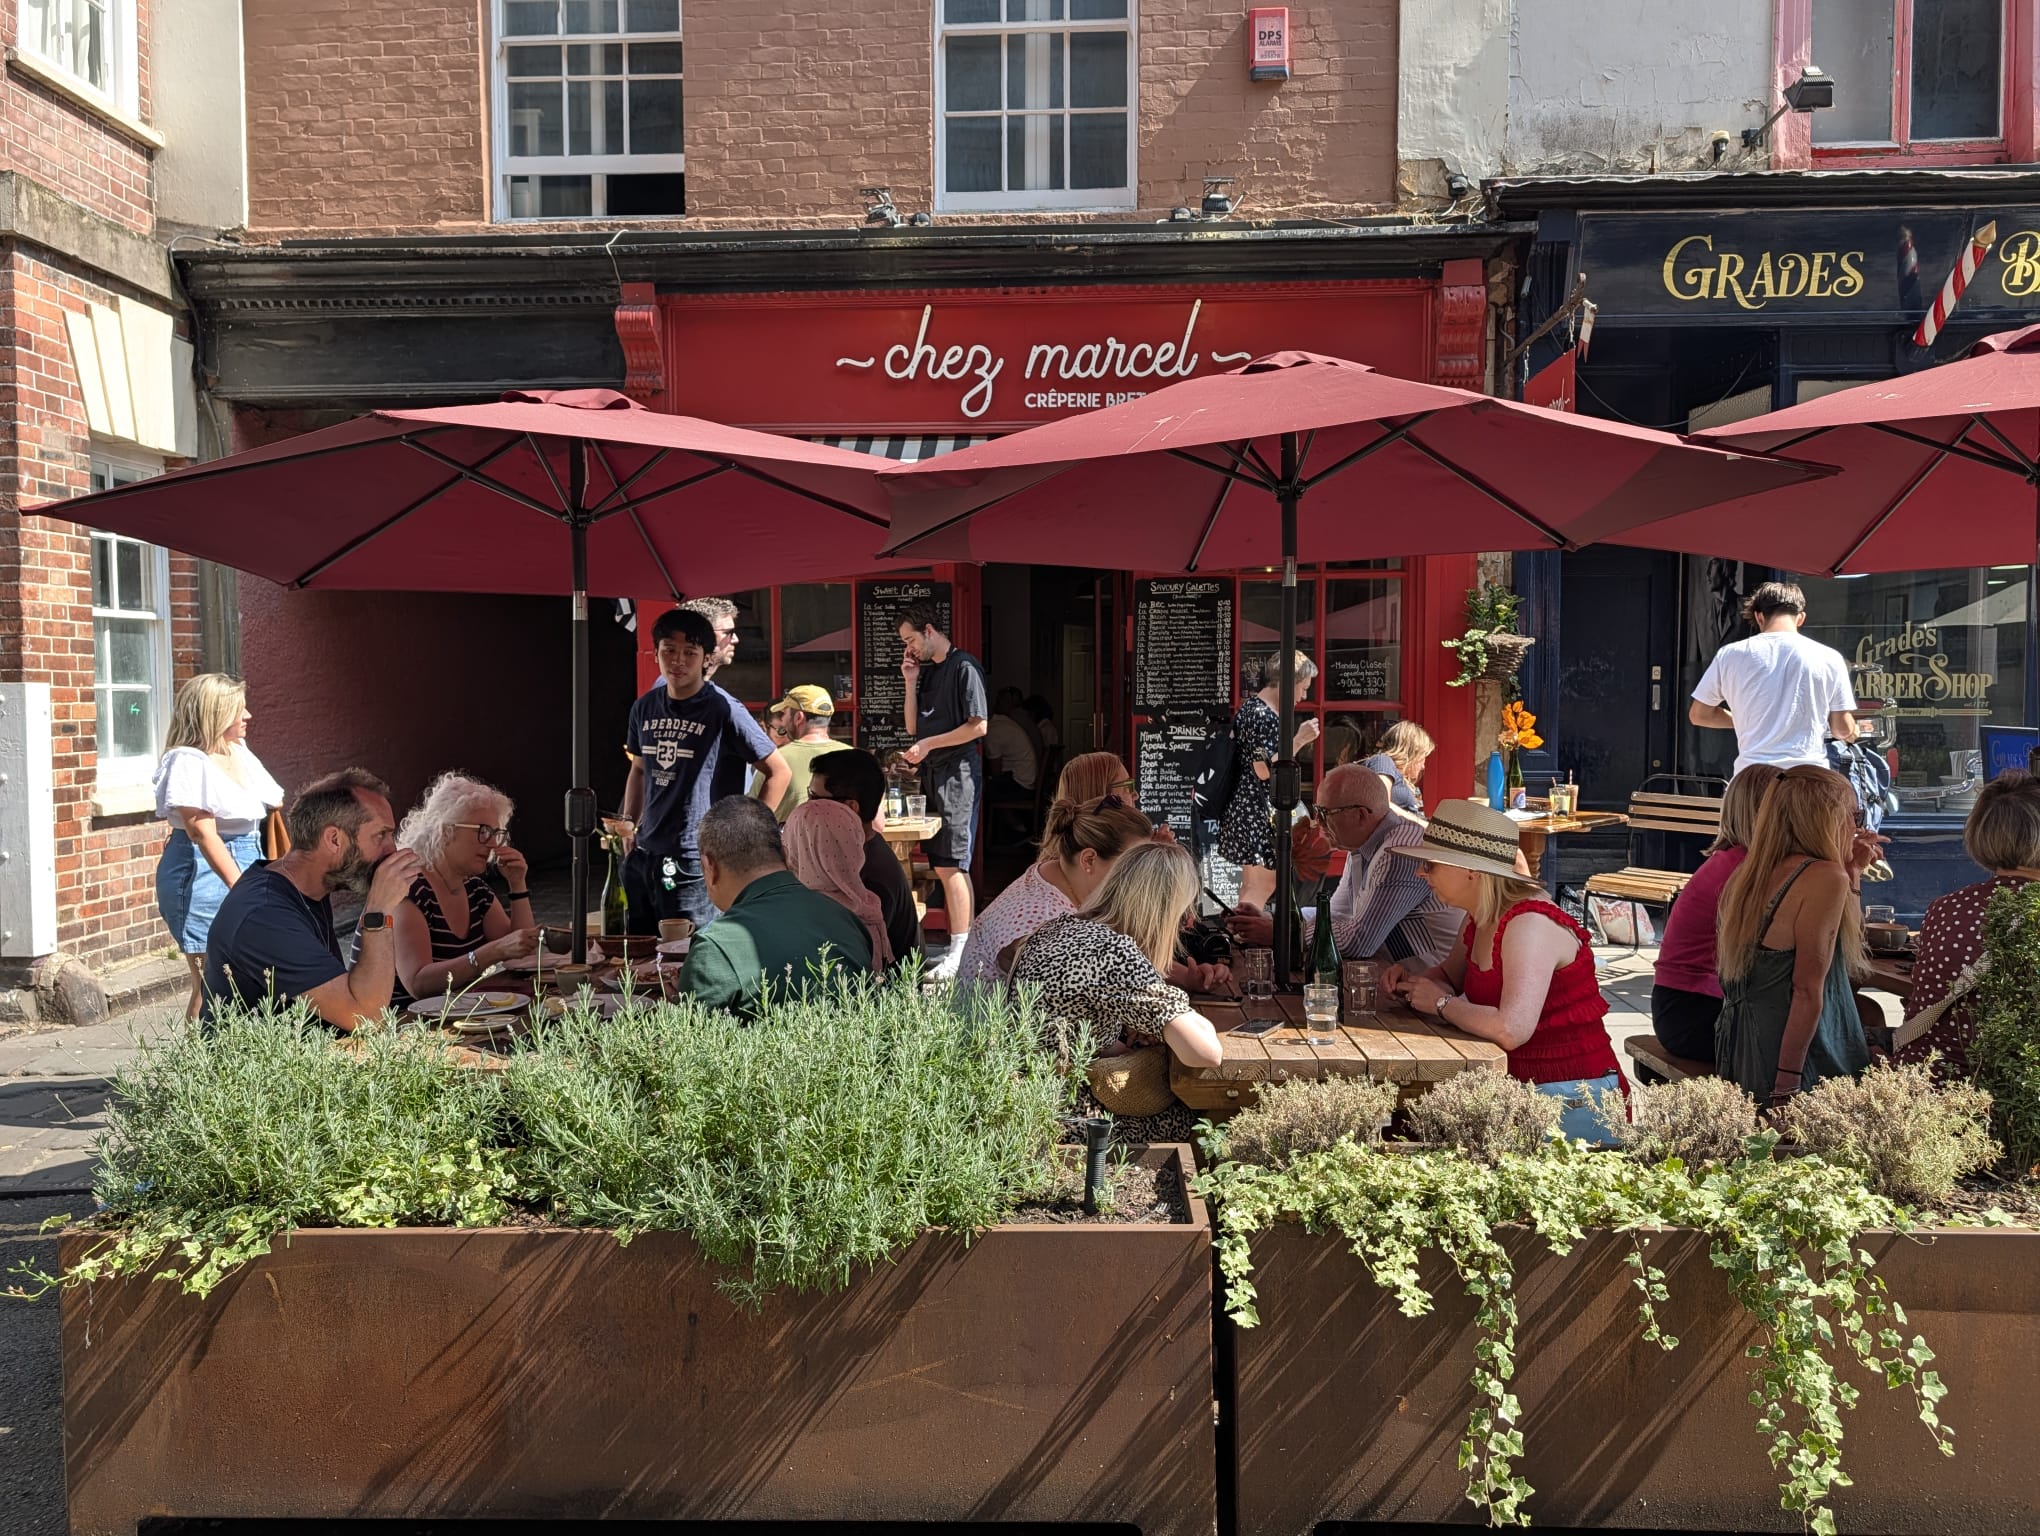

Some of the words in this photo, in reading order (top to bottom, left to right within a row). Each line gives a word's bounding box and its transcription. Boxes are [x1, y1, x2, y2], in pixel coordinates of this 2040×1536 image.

[1259, 30, 1282, 41] DPS
[884, 304, 1004, 418] chez
[1024, 298, 1202, 379] marcel
[1024, 387, 1102, 409] CRÊPERIE
[1854, 672, 1923, 699] ARBER
[642, 718, 706, 736] ABERDEEN
[658, 745, 676, 762] 23
